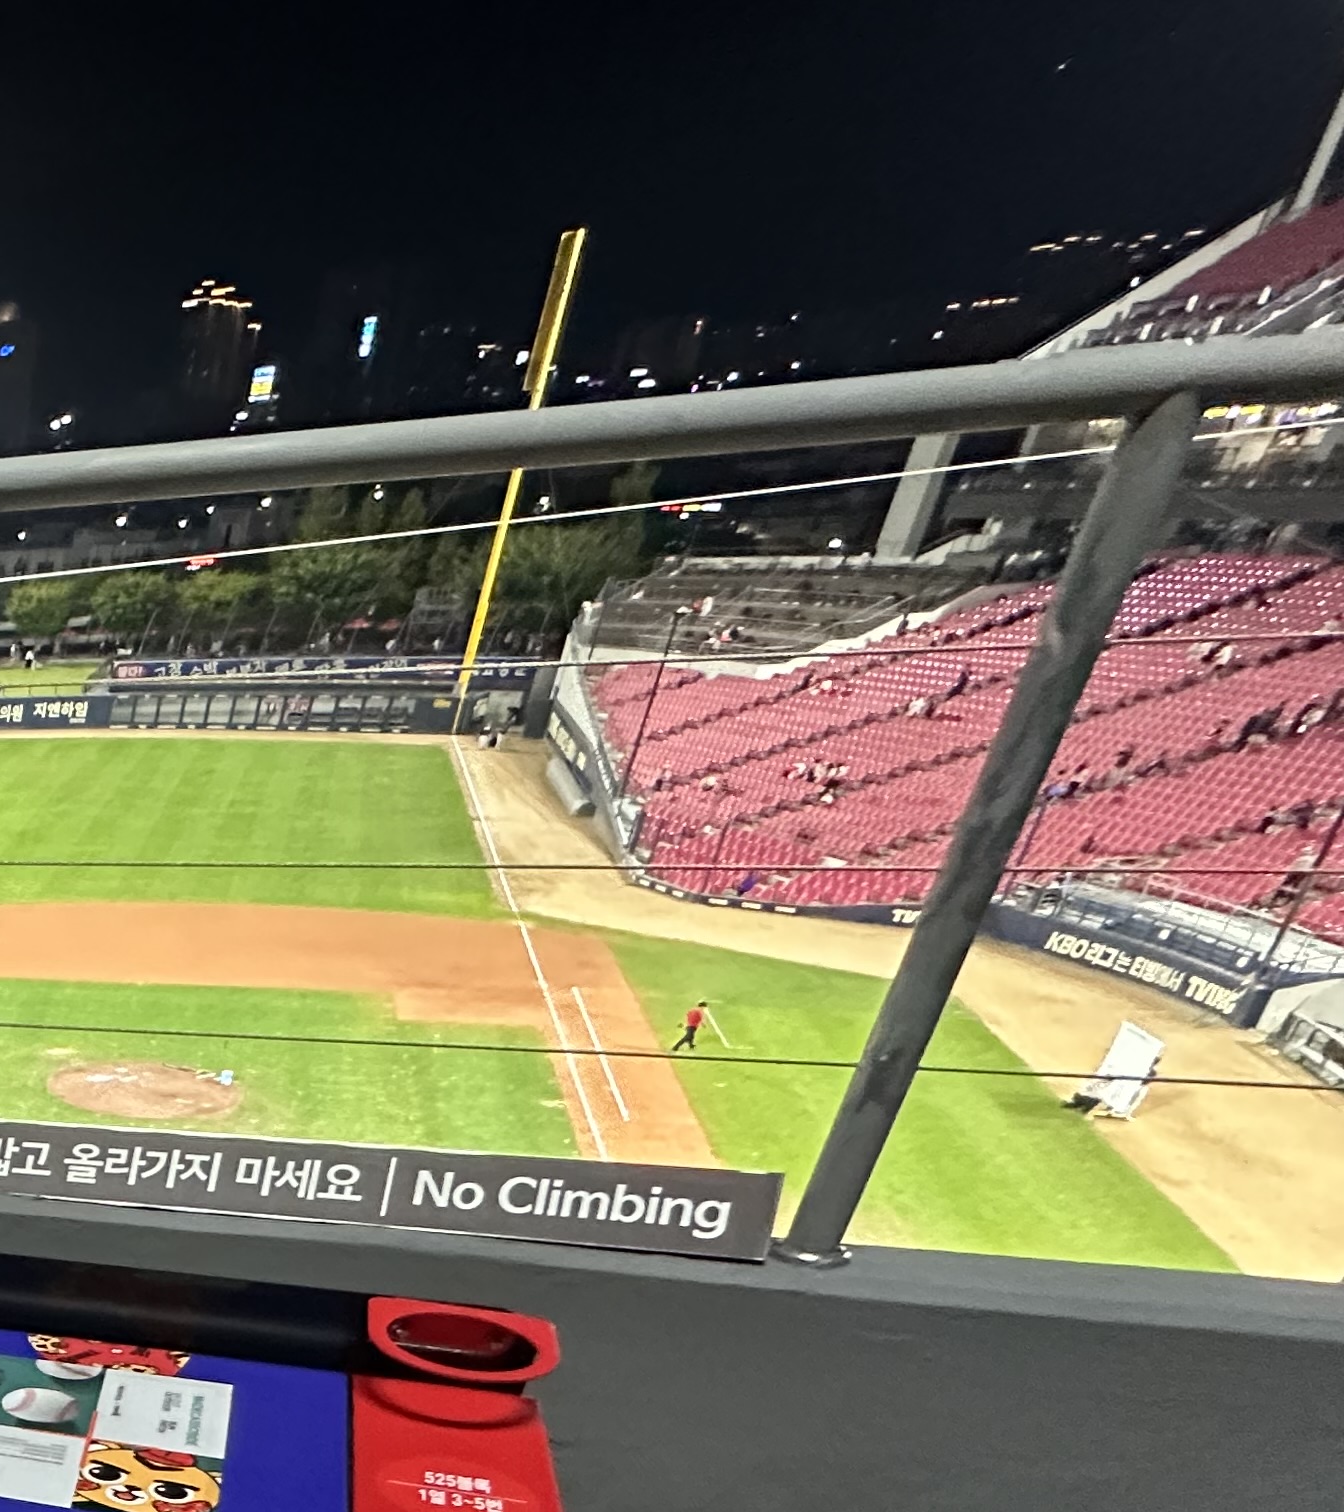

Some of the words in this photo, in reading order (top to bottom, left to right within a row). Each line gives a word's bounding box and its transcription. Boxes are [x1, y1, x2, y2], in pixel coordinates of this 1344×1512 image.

[62, 1141, 222, 1194] 올라가지
[234, 1149, 363, 1203] 마세요
[413, 1167, 485, 1212] No
[498, 1175, 732, 1239] Climbing
